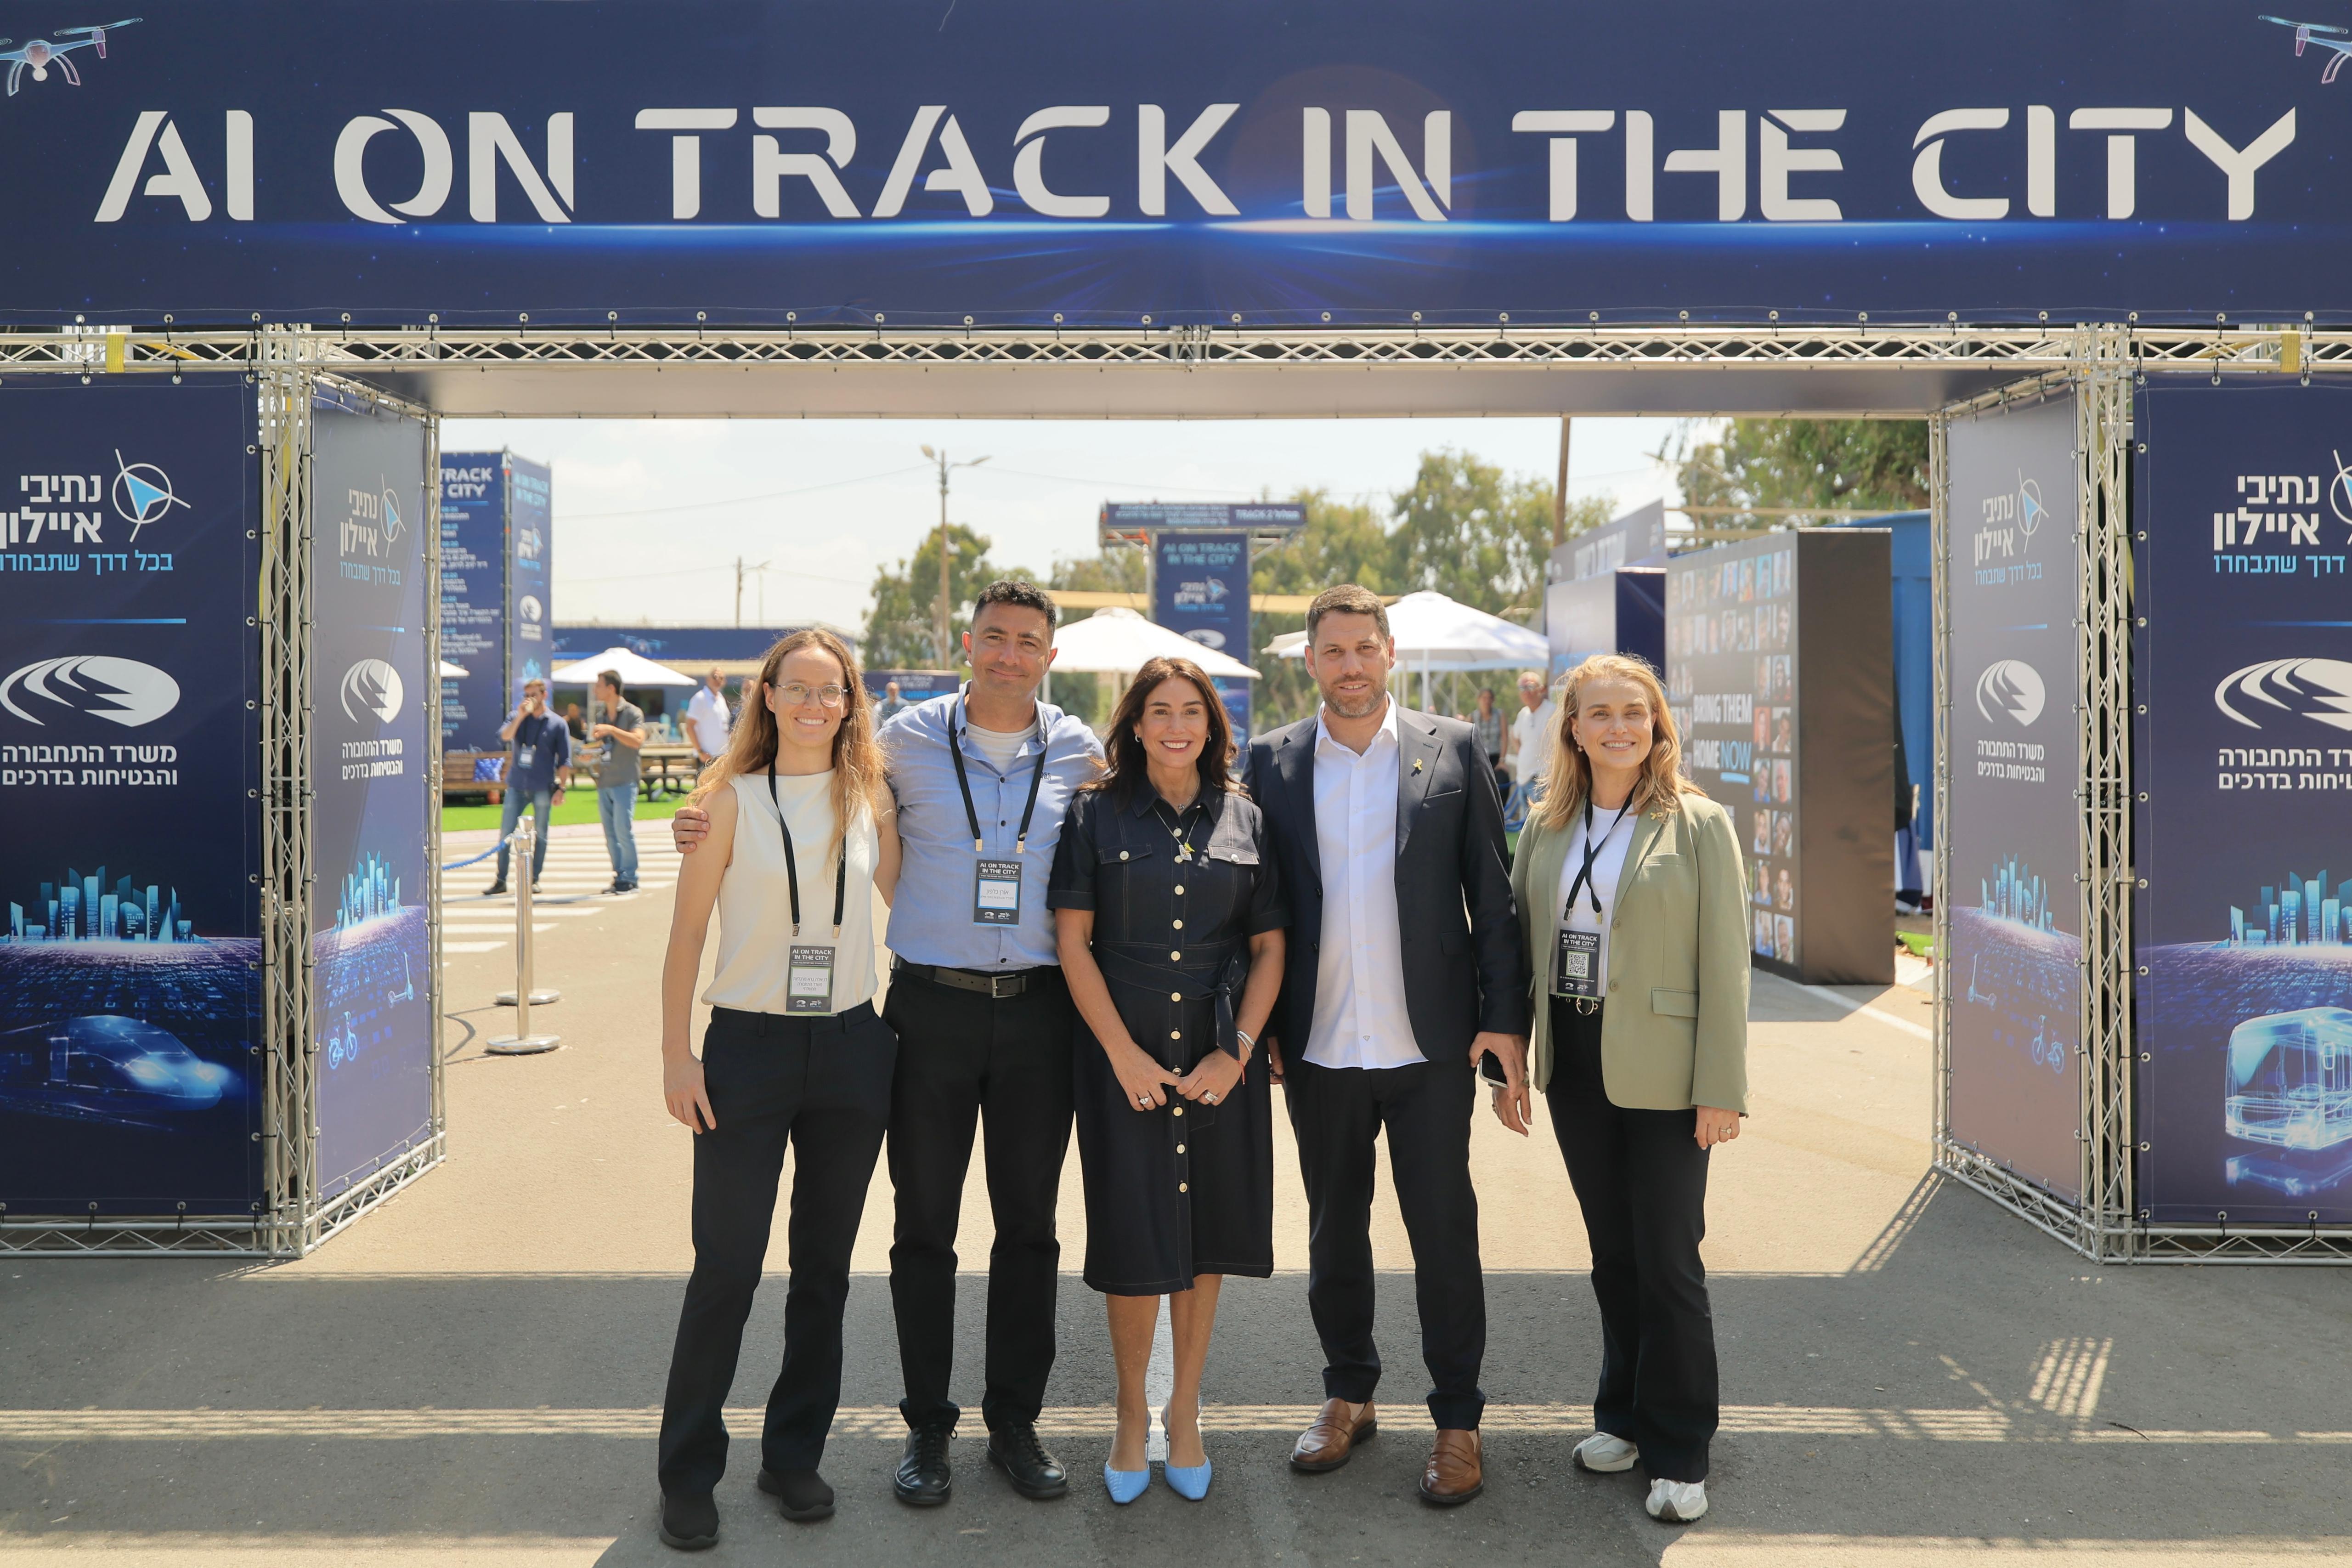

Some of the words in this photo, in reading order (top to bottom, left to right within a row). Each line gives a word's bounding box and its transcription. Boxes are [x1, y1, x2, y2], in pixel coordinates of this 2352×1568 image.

[95, 111, 253, 221] AI
[334, 110, 573, 223] ON
[636, 104, 1240, 218] TRACK
[1304, 108, 1450, 221] IN
[1513, 110, 1846, 220] THE
[1913, 106, 2295, 220] CITY
[21, 475, 101, 502] נתיבי
[447, 483, 486, 498] CITY
[2238, 475, 2319, 504] נתיבי
[349, 489, 377, 519] נתיבי
[1983, 493, 2013, 523] נתיבי
[0, 506, 103, 549] איילון
[340, 518, 378, 556] איילון
[2214, 507, 2320, 551] איילון
[1199, 543, 1240, 554] TRACK
[1975, 526, 2013, 566] איילון
[0, 554, 79, 571] שתבחרו
[88, 554, 128, 575] דרך
[135, 549, 173, 571] בכל
[1207, 554, 1236, 565] CITY
[2214, 555, 2296, 573] שתבחרו
[2305, 555, 2345, 577] דרך
[340, 561, 369, 581] שתבחרו
[372, 566, 385, 586] דרך
[388, 565, 401, 585] בכל
[1975, 567, 2005, 585] שתבחרו
[2008, 565, 2023, 586] דרך
[2026, 560, 2042, 579] בכל
[1693, 694, 1720, 724] BRING
[1722, 693, 1752, 724] THEM
[2, 746, 104, 762] התחבורה
[110, 746, 177, 762] משרד
[342, 740, 379, 759] התחבורה
[380, 739, 402, 755] משרד
[1693, 739, 1719, 770] HOME
[1720, 740, 1752, 771] NOW
[1978, 740, 2015, 758] התחבורה
[2018, 743, 2044, 761] משרד
[2219, 749, 2321, 767] התחבורה
[2327, 749, 2352, 767] רד
[2, 769, 75, 785] בדרכים
[81, 769, 177, 785] והבטיחות
[342, 764, 369, 780] בדרכים
[370, 760, 403, 777] והבטיחות
[1978, 761, 2004, 778] בדרכים
[2007, 764, 2044, 783] והבטיחות
[2219, 773, 2292, 790] בדרכים
[2298, 773, 2352, 790] יחות
